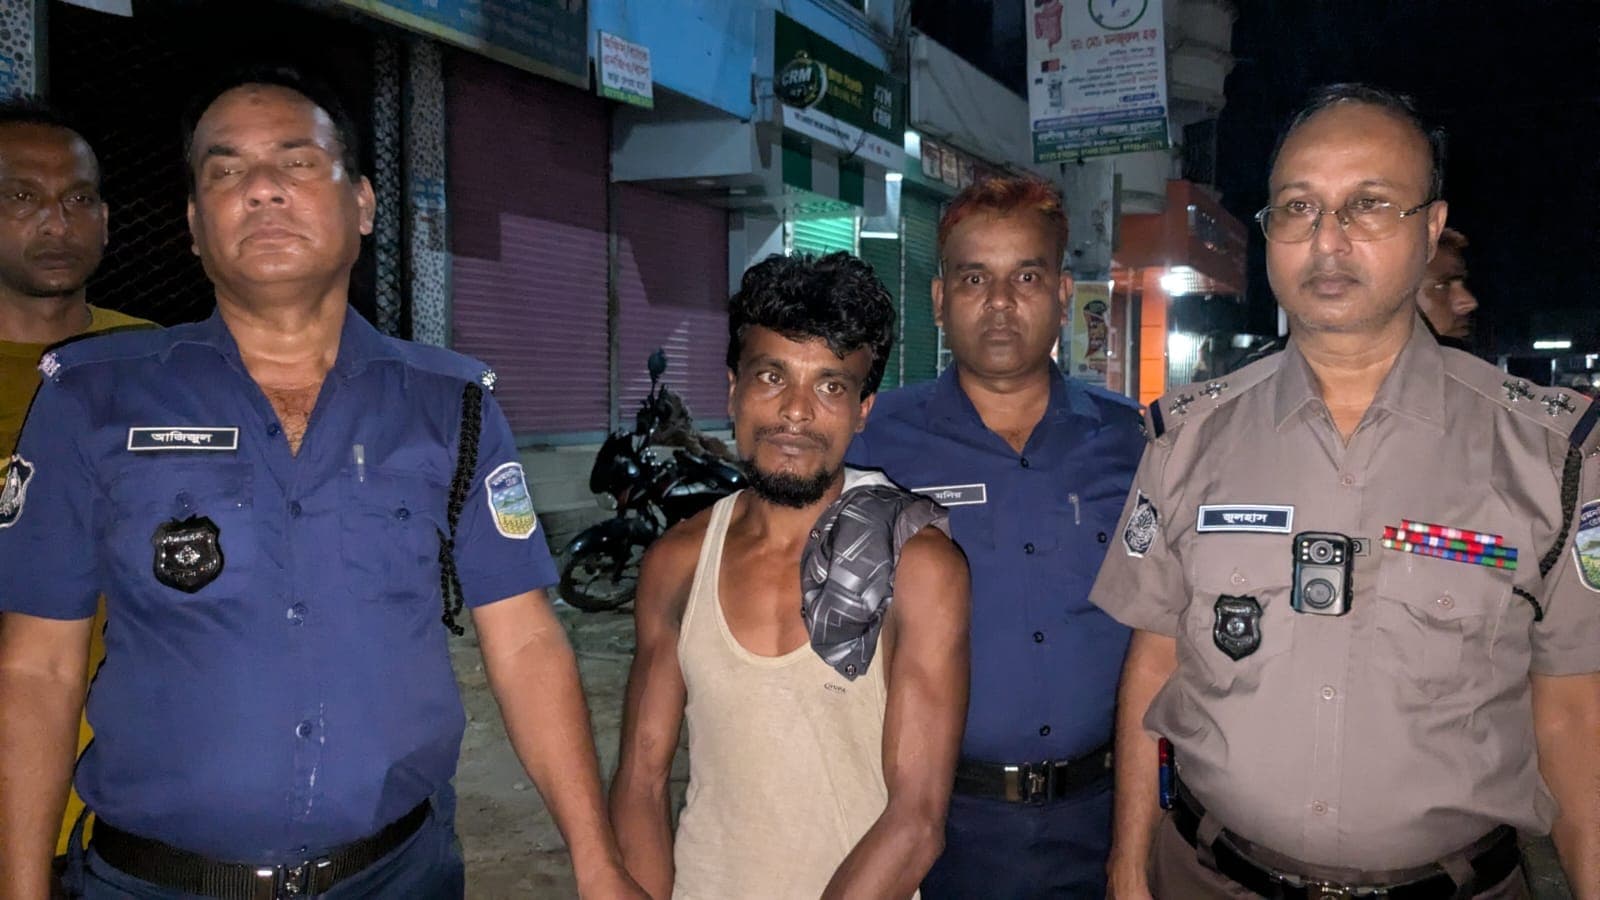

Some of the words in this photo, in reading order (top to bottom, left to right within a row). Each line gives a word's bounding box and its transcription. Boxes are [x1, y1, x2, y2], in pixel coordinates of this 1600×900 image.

[782, 67, 813, 86] CRM
[151, 431, 212, 444] আজিজুল
[1222, 512, 1268, 524] জুলহাস
